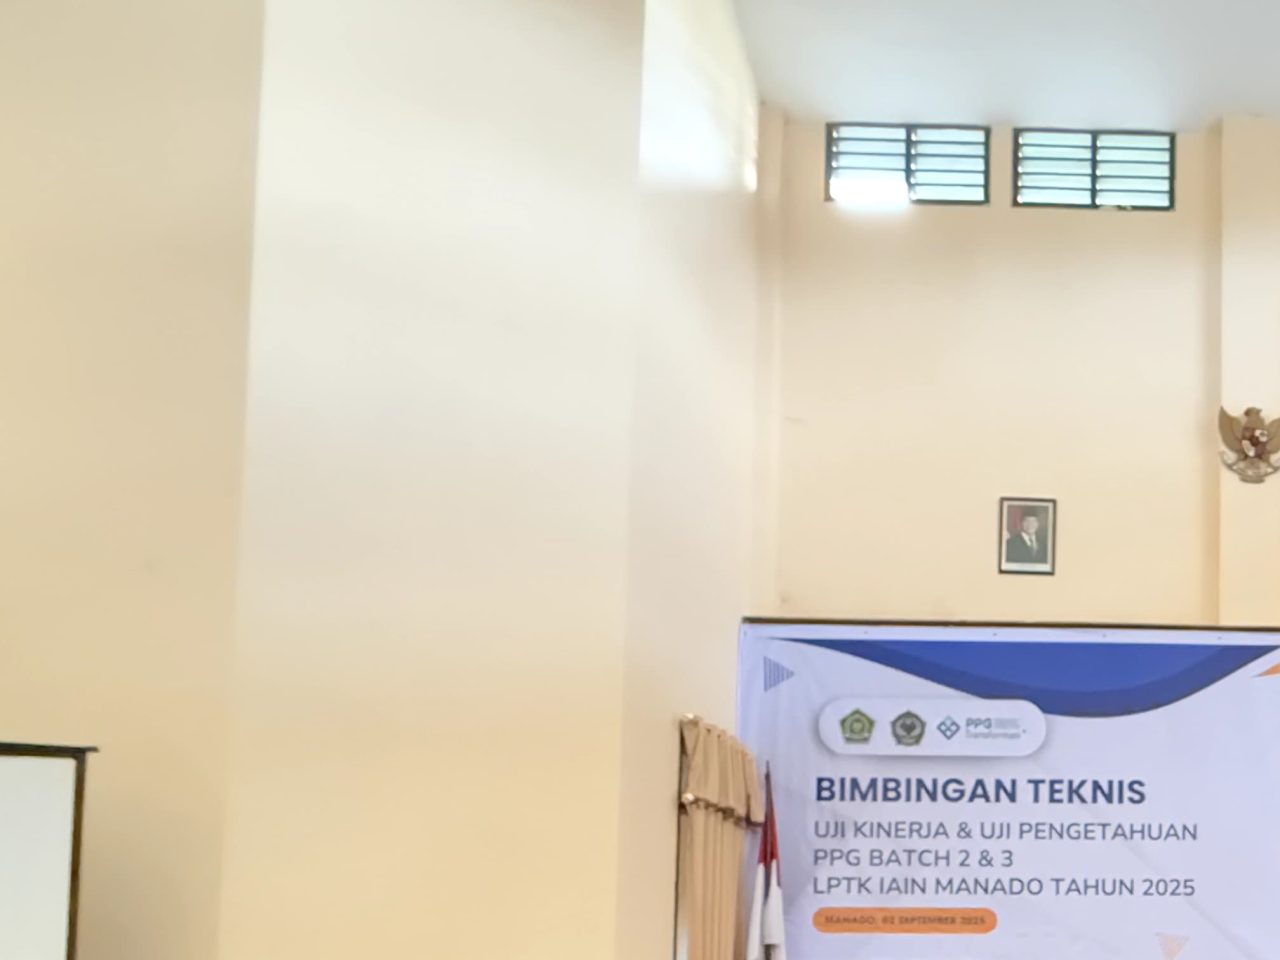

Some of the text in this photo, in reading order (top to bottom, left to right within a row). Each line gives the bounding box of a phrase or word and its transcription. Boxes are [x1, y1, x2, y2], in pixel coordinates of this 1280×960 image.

[965, 717, 993, 730] PPG
[815, 777, 1146, 805] BIMBINGAN TEKNIS
[814, 820, 1198, 841] UJI KINERJA & UJI PENGETAHUAN
[813, 849, 1014, 867] PPG BATCH 2 & 3
[813, 876, 1196, 896] LPTK IAIN MANADO TAHUN 2025
